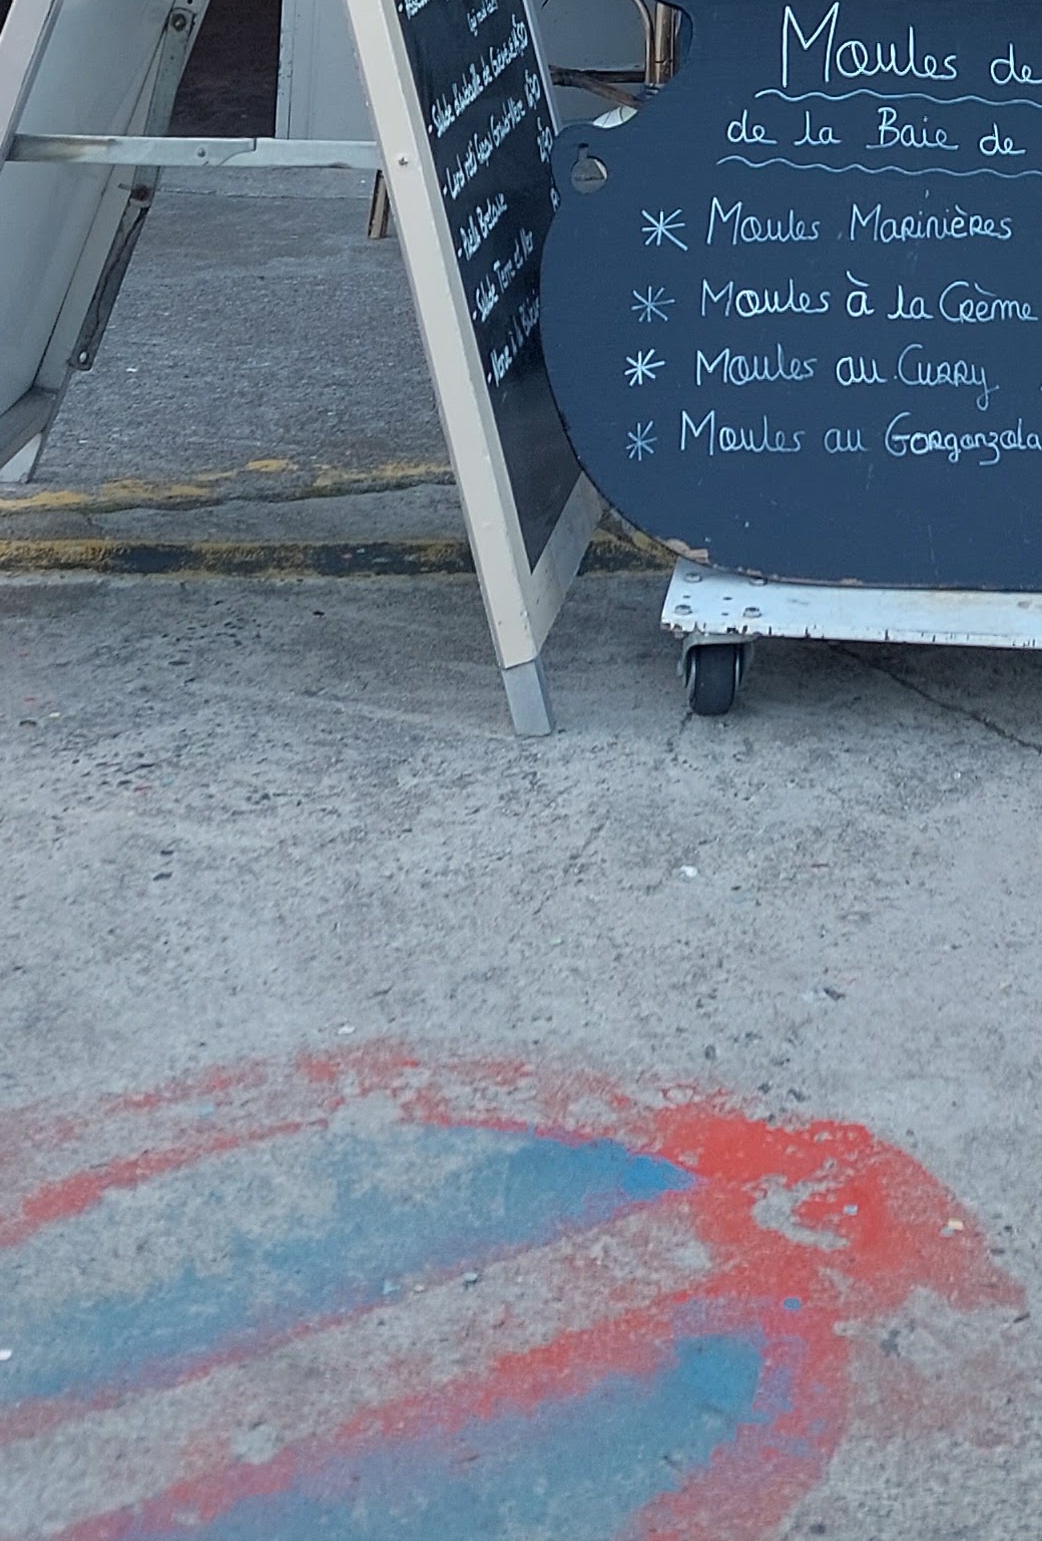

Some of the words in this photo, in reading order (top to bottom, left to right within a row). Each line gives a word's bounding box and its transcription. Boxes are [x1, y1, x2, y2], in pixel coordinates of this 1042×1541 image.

[779, 1, 957, 87] Moules
[726, 108, 777, 146] de
[796, 109, 841, 148] la
[870, 106, 959, 151] Baie
[979, 121, 1027, 158] de
[706, 199, 820, 248] Moules
[847, 202, 1013, 244] Marinières
[699, 278, 831, 319] Moules
[846, 269, 875, 318] à
[886, 283, 933, 319] la
[936, 280, 1039, 324] Crème
[694, 346, 818, 387] Moules
[835, 355, 887, 389] au
[896, 342, 999, 410] Curry
[679, 409, 803, 455] Moules
[824, 425, 868, 453] au
[885, 410, 1042, 467] Gorgonzola
